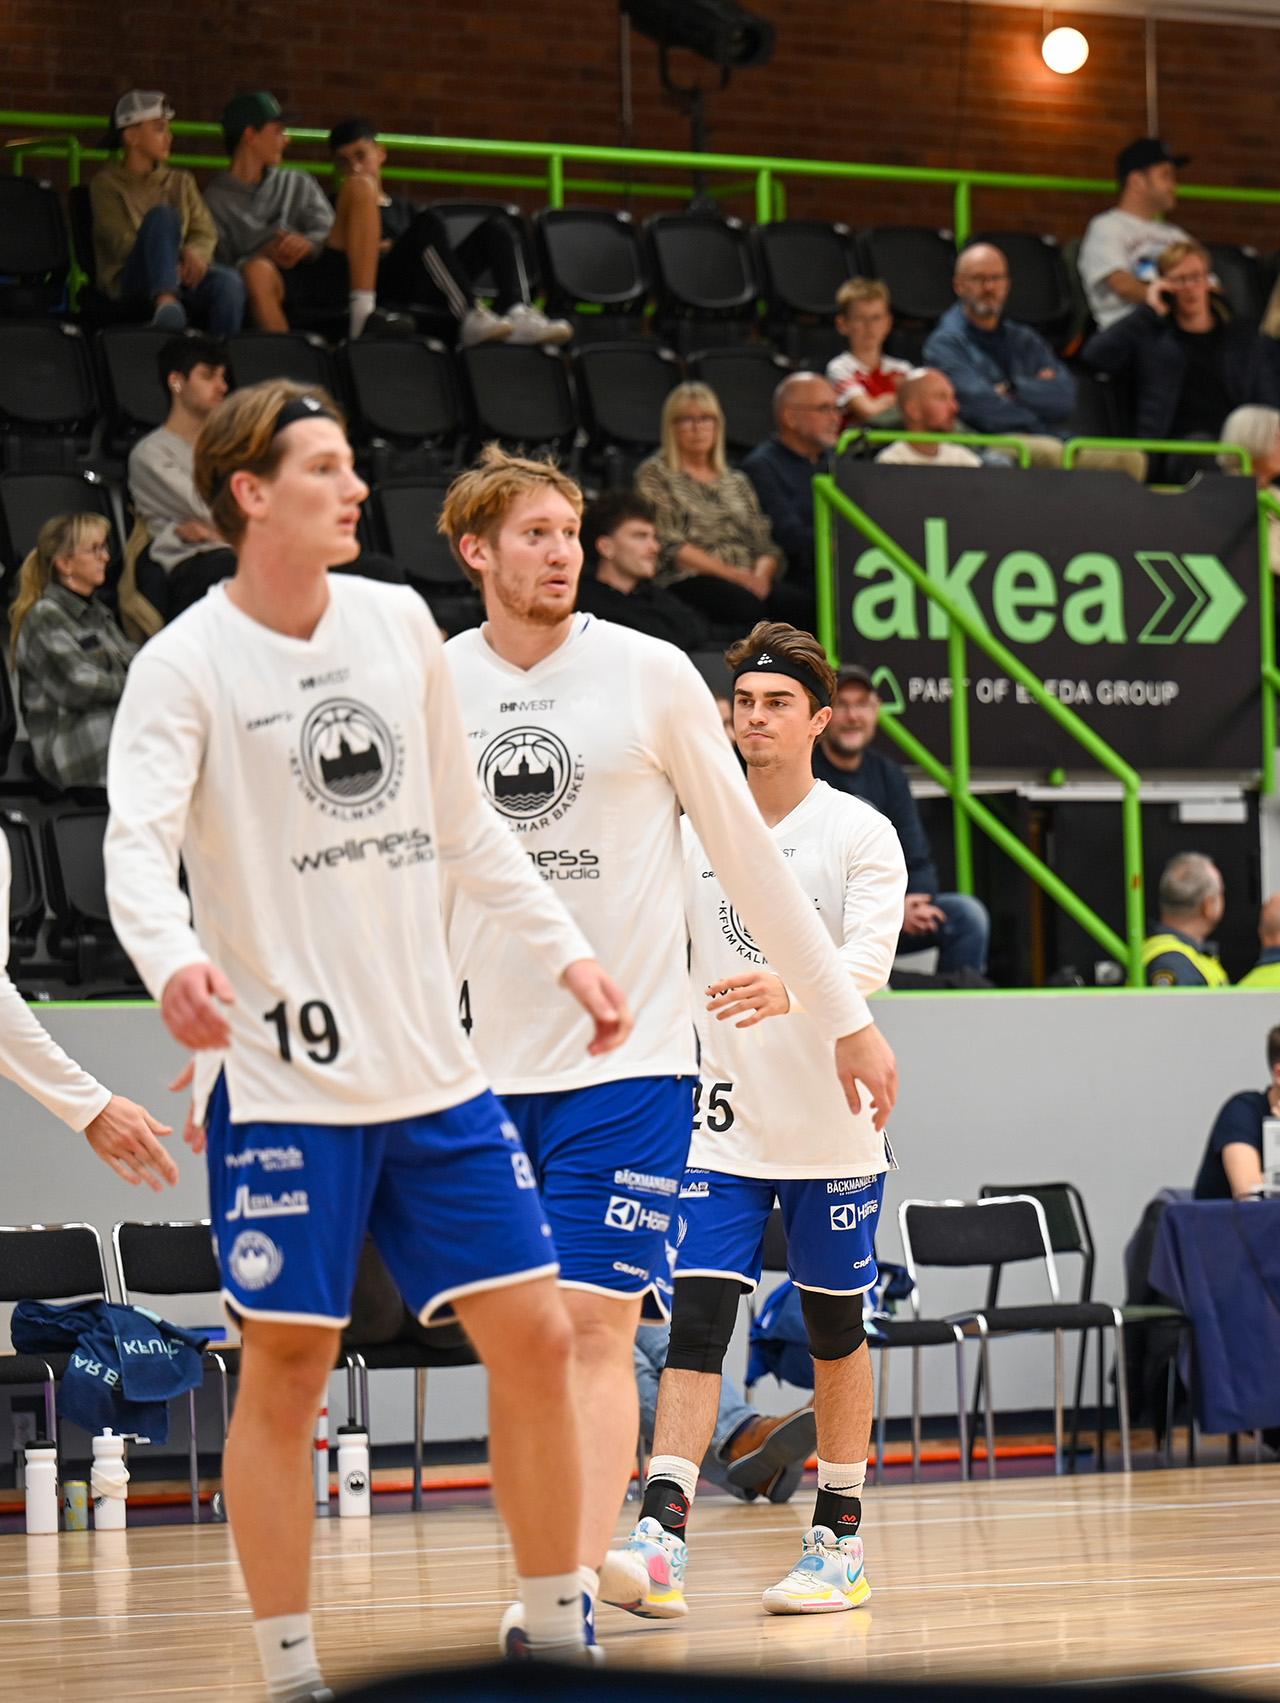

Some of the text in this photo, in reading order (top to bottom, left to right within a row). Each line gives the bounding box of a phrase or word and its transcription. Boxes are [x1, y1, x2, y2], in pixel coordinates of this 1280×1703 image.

[852, 517, 1128, 645] akea
[908, 676, 971, 703] PAR
[976, 678, 1011, 704] OF
[1096, 679, 1181, 706] GROUP
[509, 762, 585, 833] MAR BASKET
[290, 827, 432, 874] wellness
[526, 849, 600, 867] ness
[539, 867, 601, 881] studio
[718, 906, 769, 965] KFUM KAL
[264, 998, 341, 1065] 19
